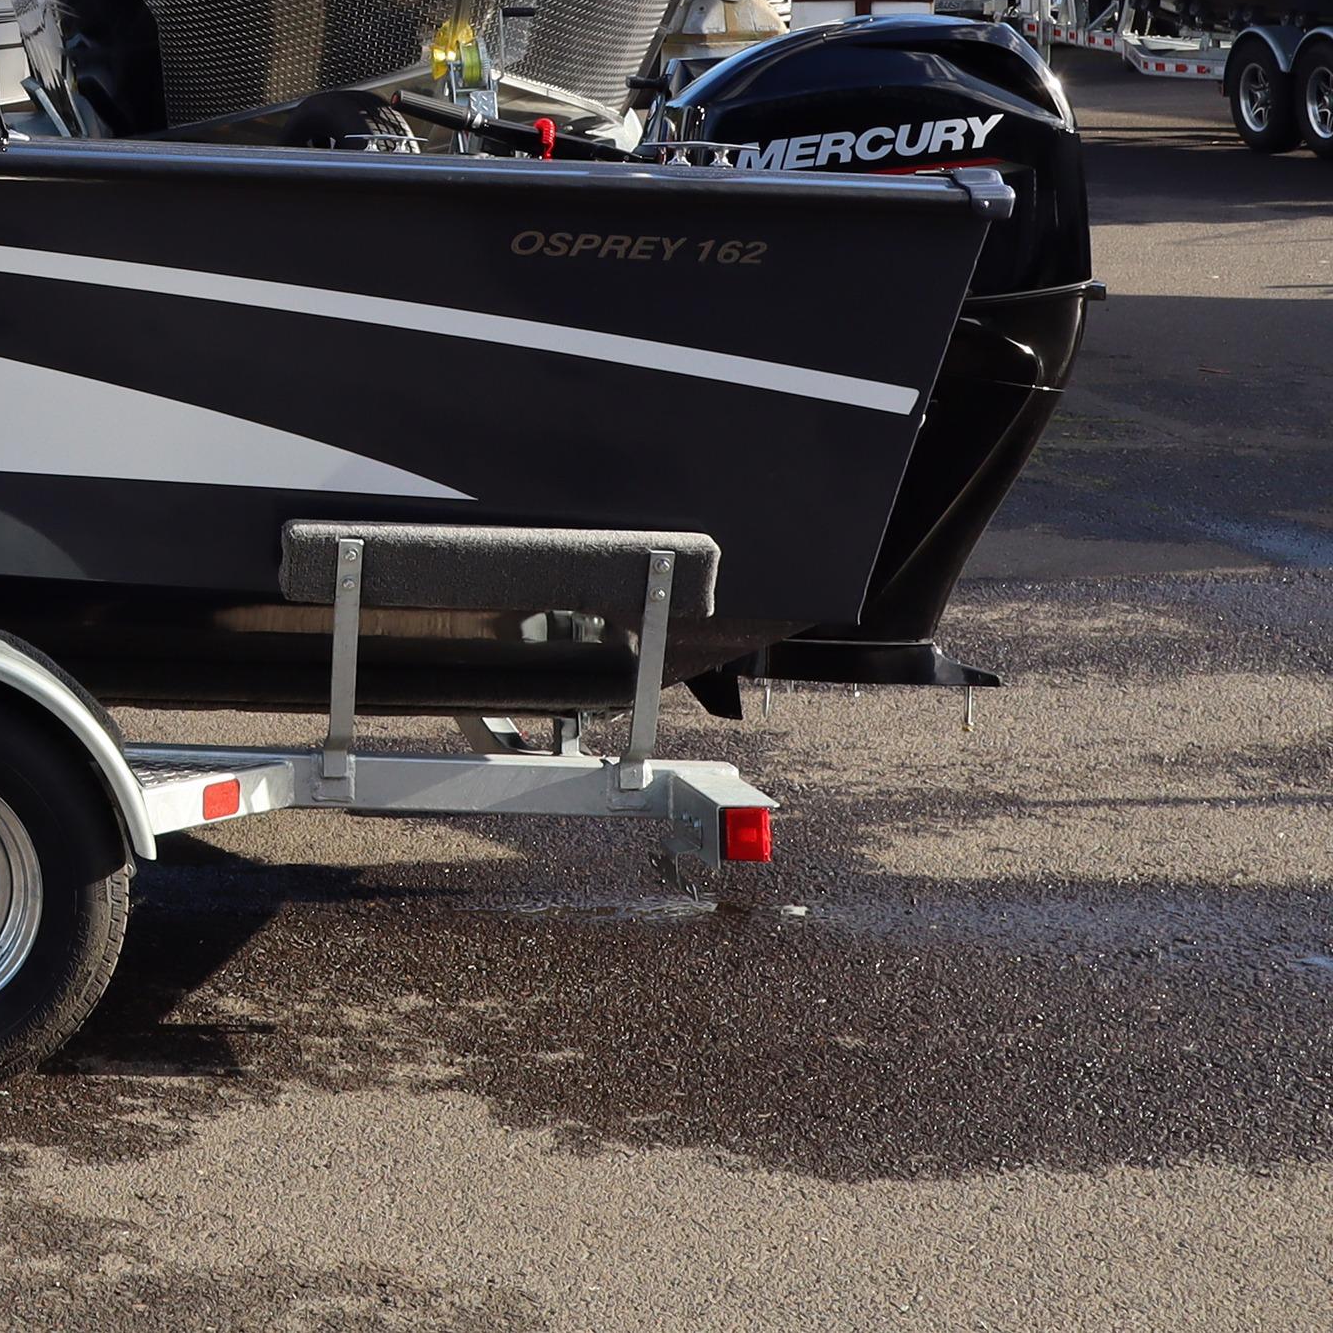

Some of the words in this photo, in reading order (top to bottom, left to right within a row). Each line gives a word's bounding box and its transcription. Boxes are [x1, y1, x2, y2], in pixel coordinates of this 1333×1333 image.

[737, 114, 1004, 171] MERCURY
[510, 231, 687, 261] OSPREY
[697, 240, 767, 264] 162
